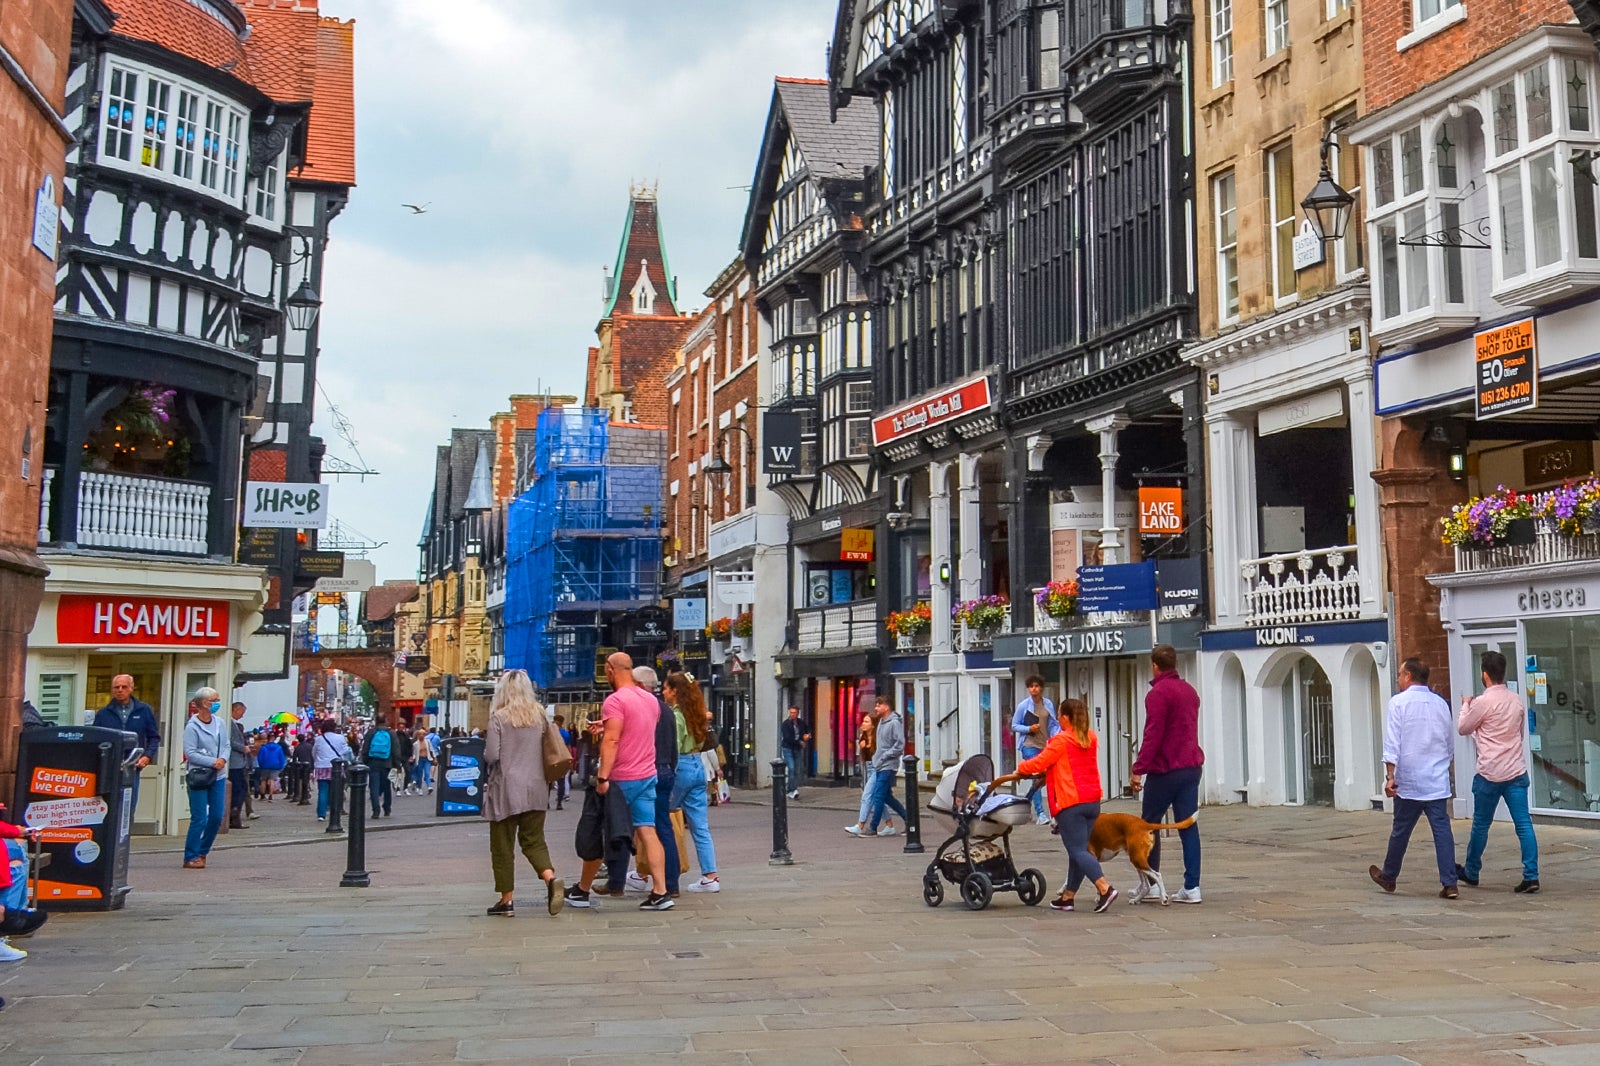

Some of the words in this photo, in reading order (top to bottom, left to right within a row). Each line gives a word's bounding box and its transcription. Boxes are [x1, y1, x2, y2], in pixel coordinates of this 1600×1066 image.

[1486, 334, 1500, 344] ROW
[1503, 326, 1521, 339] LEVEL
[1478, 342, 1500, 359] SHOP
[1502, 339, 1514, 351] TO
[1516, 334, 1530, 347] LET
[1504, 355, 1526, 368] Emanuel
[1481, 390, 1494, 405] 0151
[1496, 386, 1509, 401] 236
[1510, 382, 1530, 397] 6700
[892, 417, 902, 432] The
[902, 407, 928, 429] Edinburgh
[949, 393, 962, 412] Mill
[770, 446, 794, 462] W
[254, 488, 320, 514] SHRUB
[1142, 502, 1174, 515] LAKE
[1142, 516, 1180, 528] LAND
[1164, 589, 1198, 598] KUONI
[1518, 586, 1586, 611] chesca
[94, 603, 113, 634] H
[117, 603, 220, 637] SAMUEL
[1026, 635, 1072, 655] ERNEST
[1079, 631, 1123, 653] JONES
[1256, 627, 1297, 645] KUONI
[37, 770, 89, 787] Carefully
[35, 783, 52, 791] we
[54, 785, 74, 794] can
[32, 804, 49, 812] stay
[50, 802, 70, 810] apart
[82, 799, 100, 807] keep
[51, 810, 68, 819] high
[70, 807, 97, 816] streets
[50, 818, 82, 826] together
